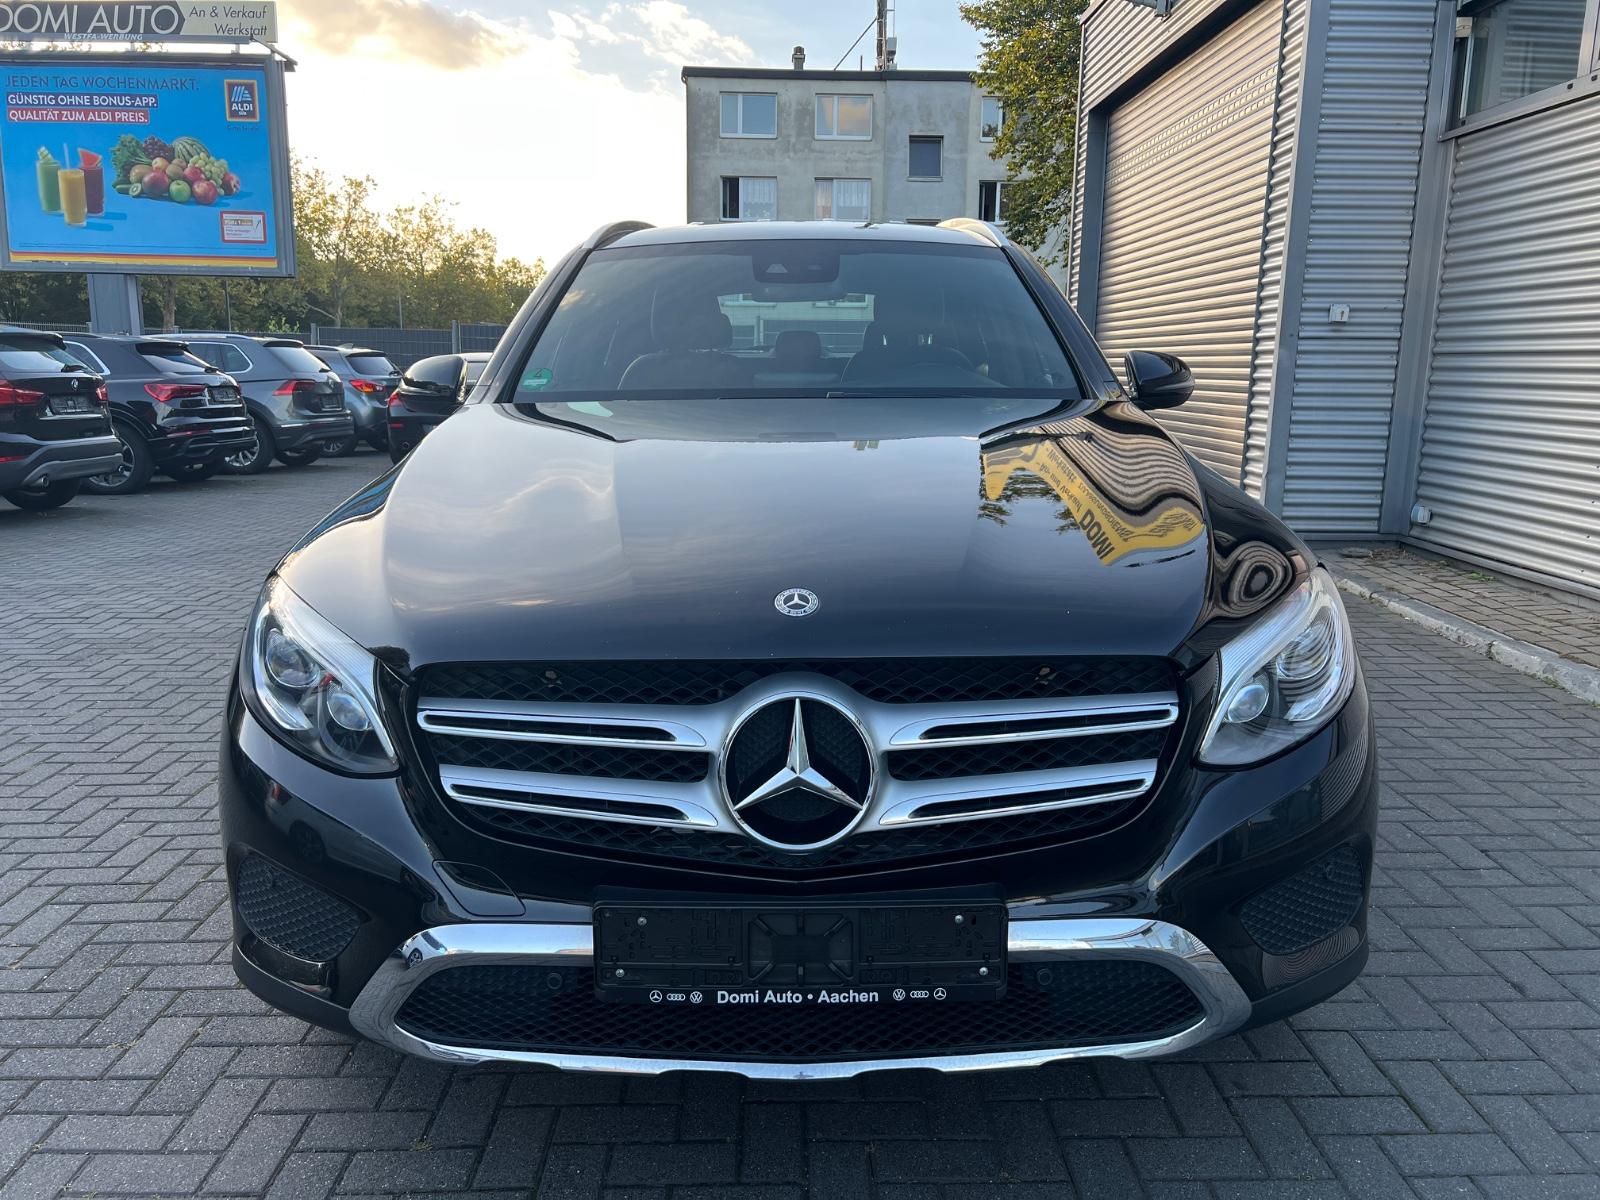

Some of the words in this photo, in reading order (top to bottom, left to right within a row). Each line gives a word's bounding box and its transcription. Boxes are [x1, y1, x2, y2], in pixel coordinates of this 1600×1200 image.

[87, 4, 179, 34] AUTO
[189, 6, 206, 18] An
[209, 6, 219, 18] &
[222, 5, 268, 19] Verkauf
[214, 23, 268, 36] Werkstatt
[64, 33, 143, 41] WESTFA-WERBUNG
[6, 76, 49, 88] JEDEN
[53, 76, 79, 88] TAG
[83, 77, 200, 91] WOCHENMARKT.
[8, 93, 55, 105] GÜNSTIG
[57, 95, 90, 106] OHNE
[93, 96, 157, 107] BONUS-APP.
[231, 103, 253, 111] ALDI
[9, 109, 59, 122] QUALITÄT
[61, 111, 85, 121] ZUM
[88, 112, 112, 122] ALDI
[115, 112, 148, 123] PREIS.
[717, 990, 760, 1004] Domi
[764, 990, 803, 1004] Auto
[817, 989, 879, 1004] Aachen
